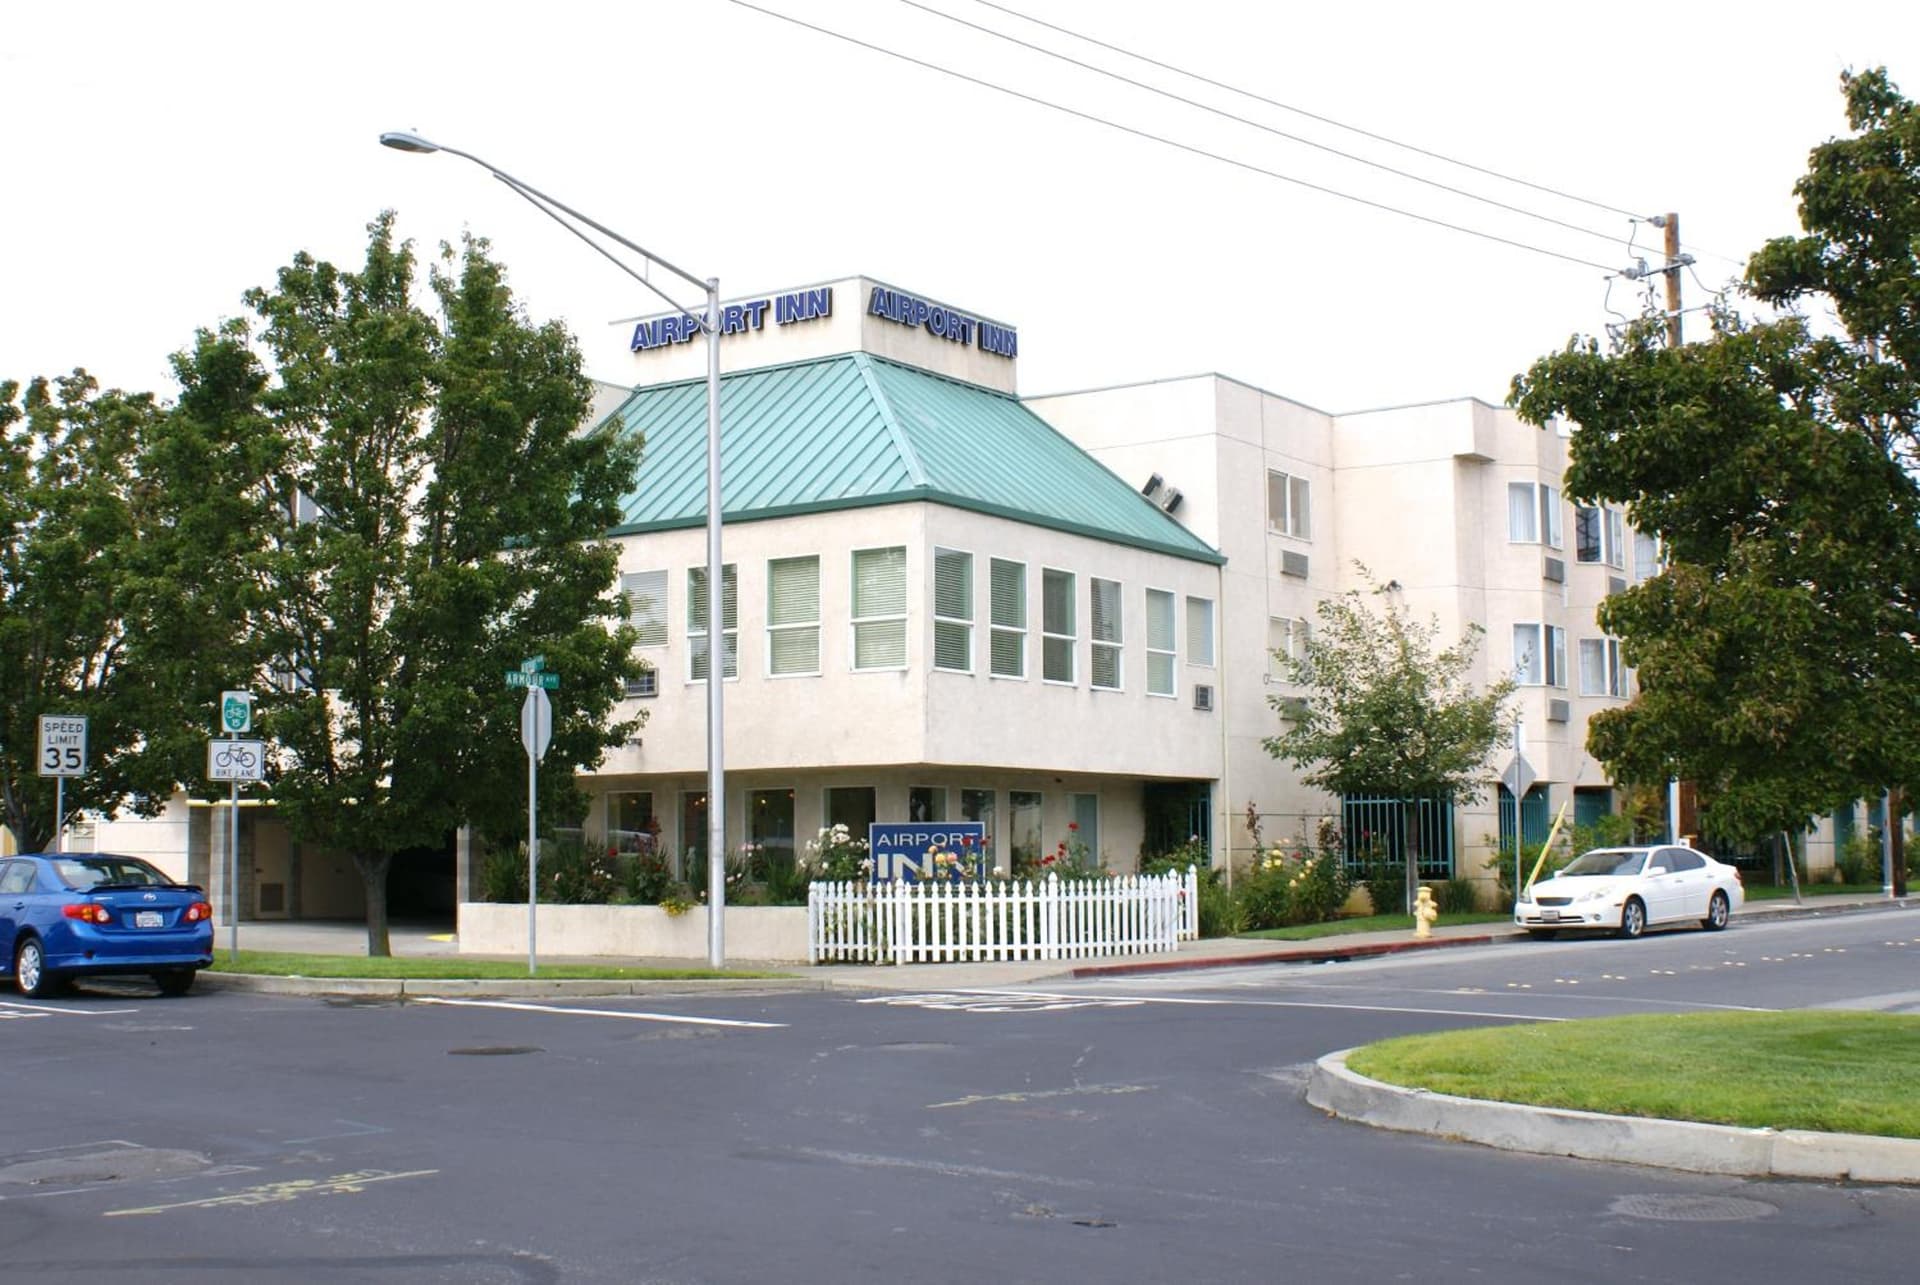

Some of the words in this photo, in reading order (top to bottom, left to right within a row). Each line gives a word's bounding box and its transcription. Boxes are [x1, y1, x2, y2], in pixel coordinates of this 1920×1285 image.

[775, 287, 832, 326] INN
[867, 286, 977, 346] AIRPORT
[978, 320, 1018, 359] INN
[44, 721, 84, 733] SPEED
[48, 735, 78, 745] LIMIT
[44, 747, 81, 769] 35
[215, 768, 233, 777] BIKE
[235, 769, 255, 778] LANE
[877, 832, 978, 847] AIRPORT
